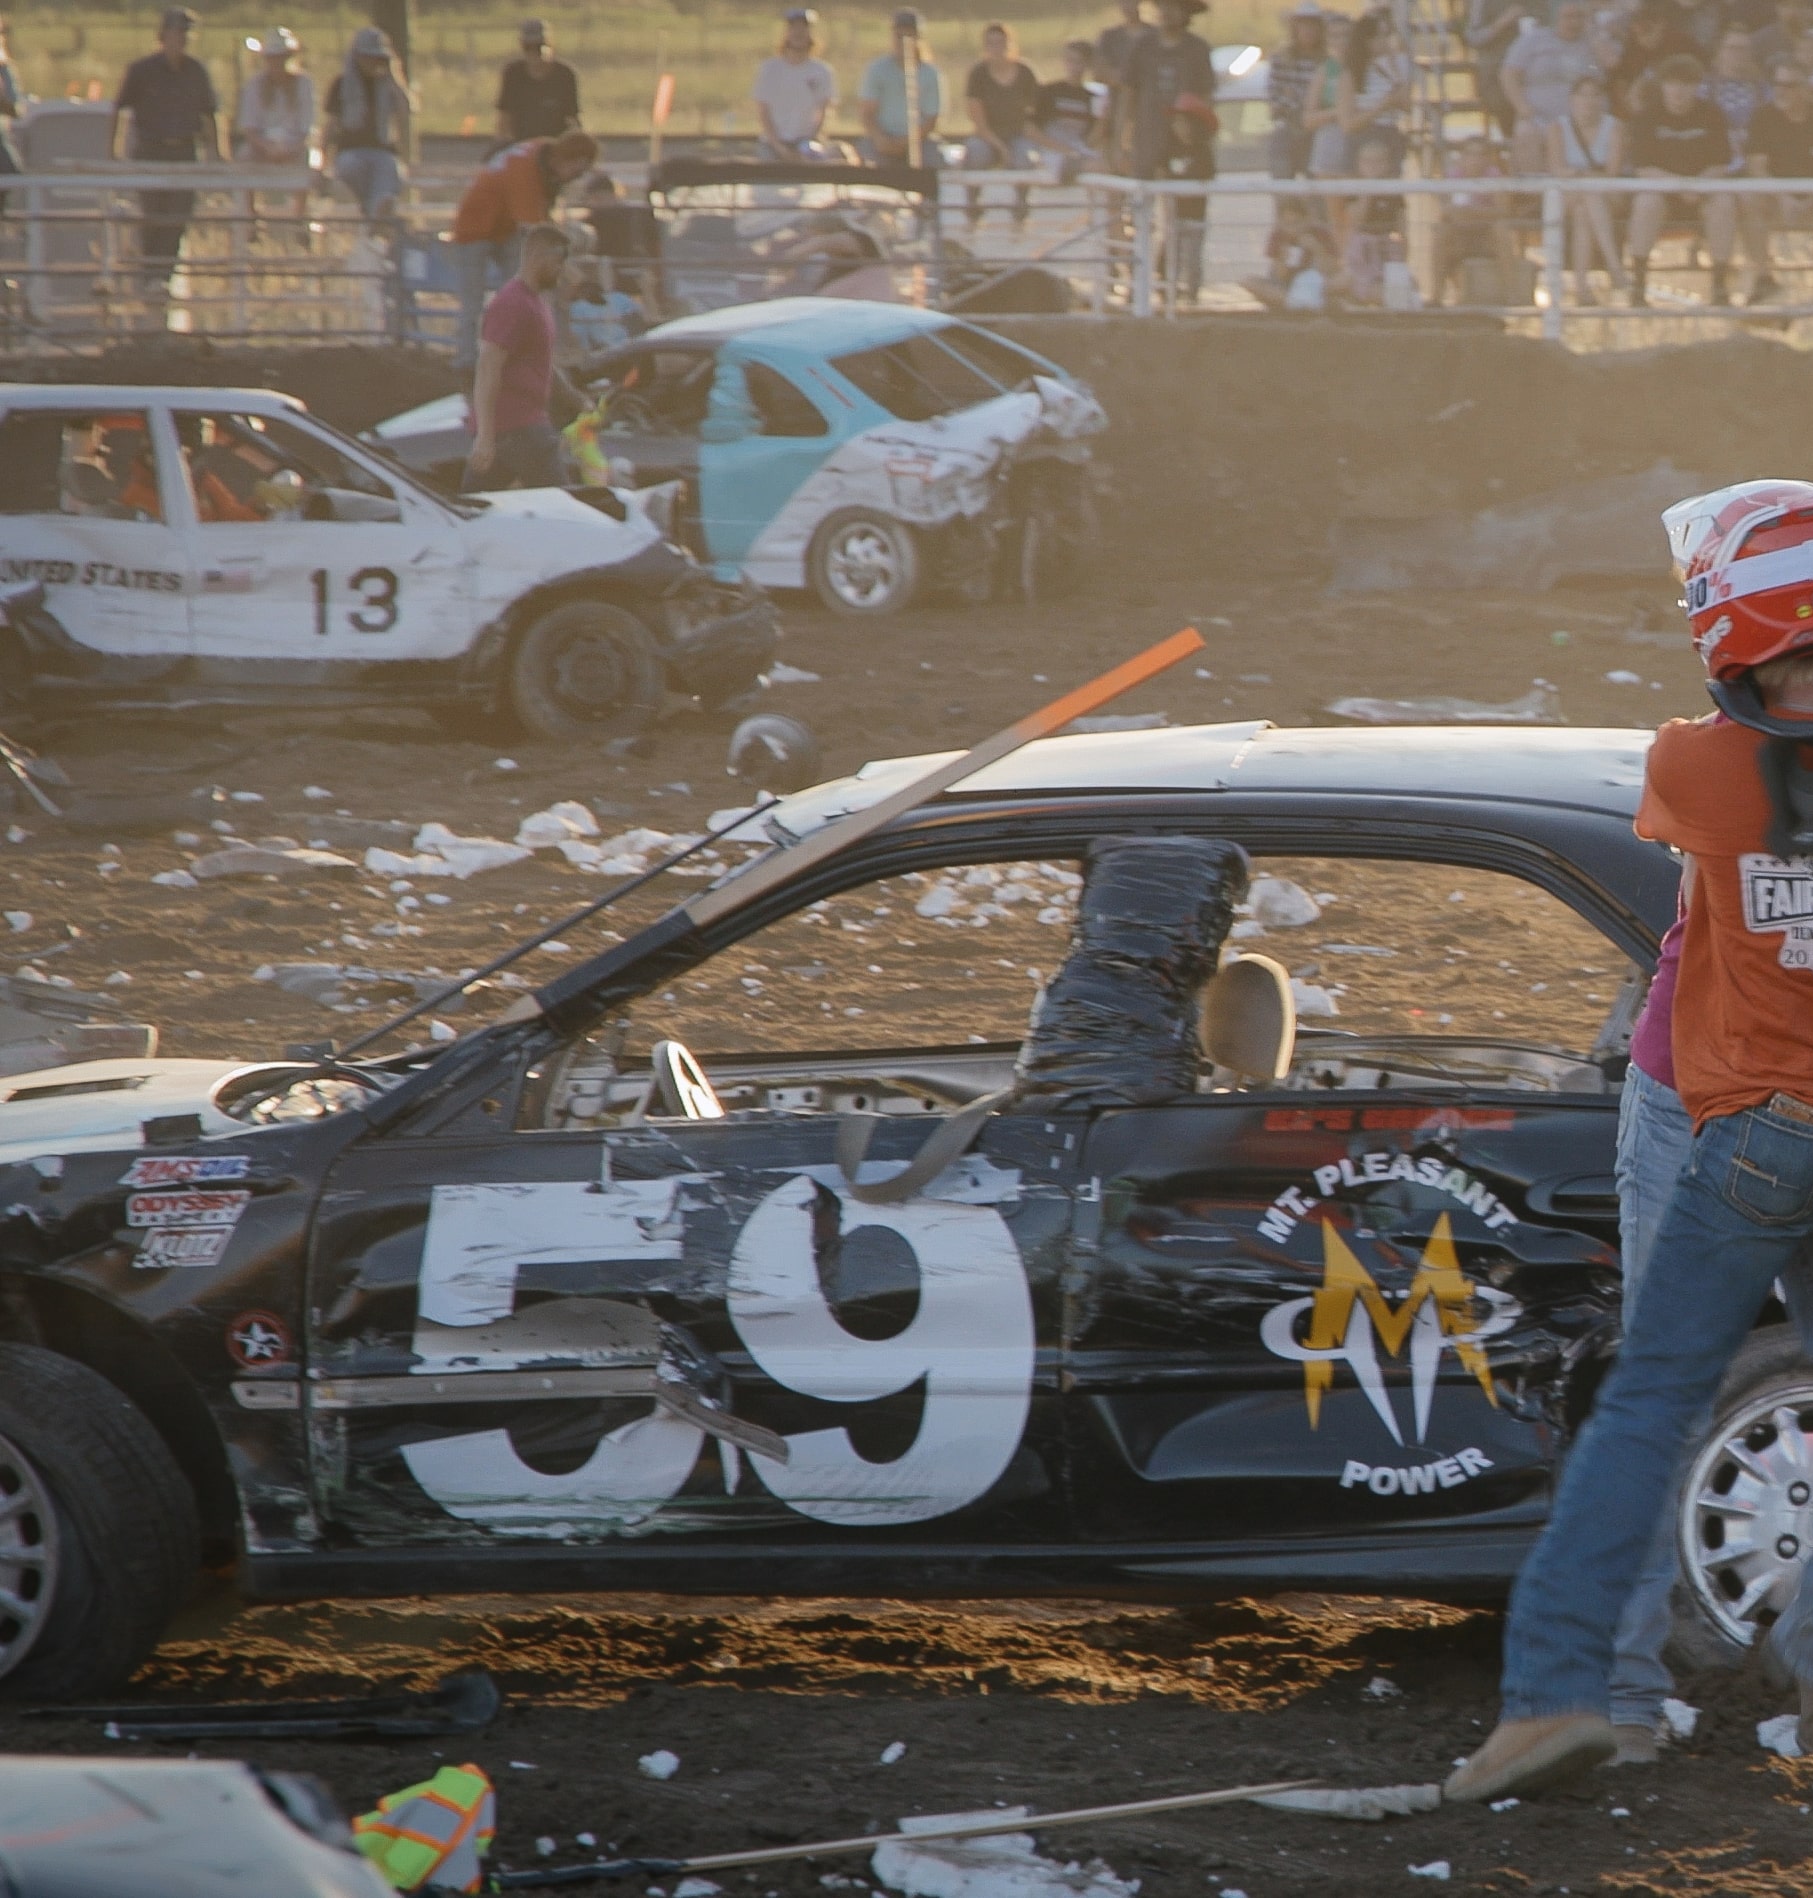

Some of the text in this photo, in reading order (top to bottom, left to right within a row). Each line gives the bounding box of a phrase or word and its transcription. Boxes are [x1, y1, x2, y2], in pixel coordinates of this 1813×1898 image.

[82, 559, 183, 592] STATES
[309, 566, 398, 635] 13
[1783, 949, 1808, 965] 20
[1257, 1152, 1519, 1244] MT. PLEASANT
[401, 1157, 1036, 1530] 59
[1339, 1446, 1492, 1496] POWER
